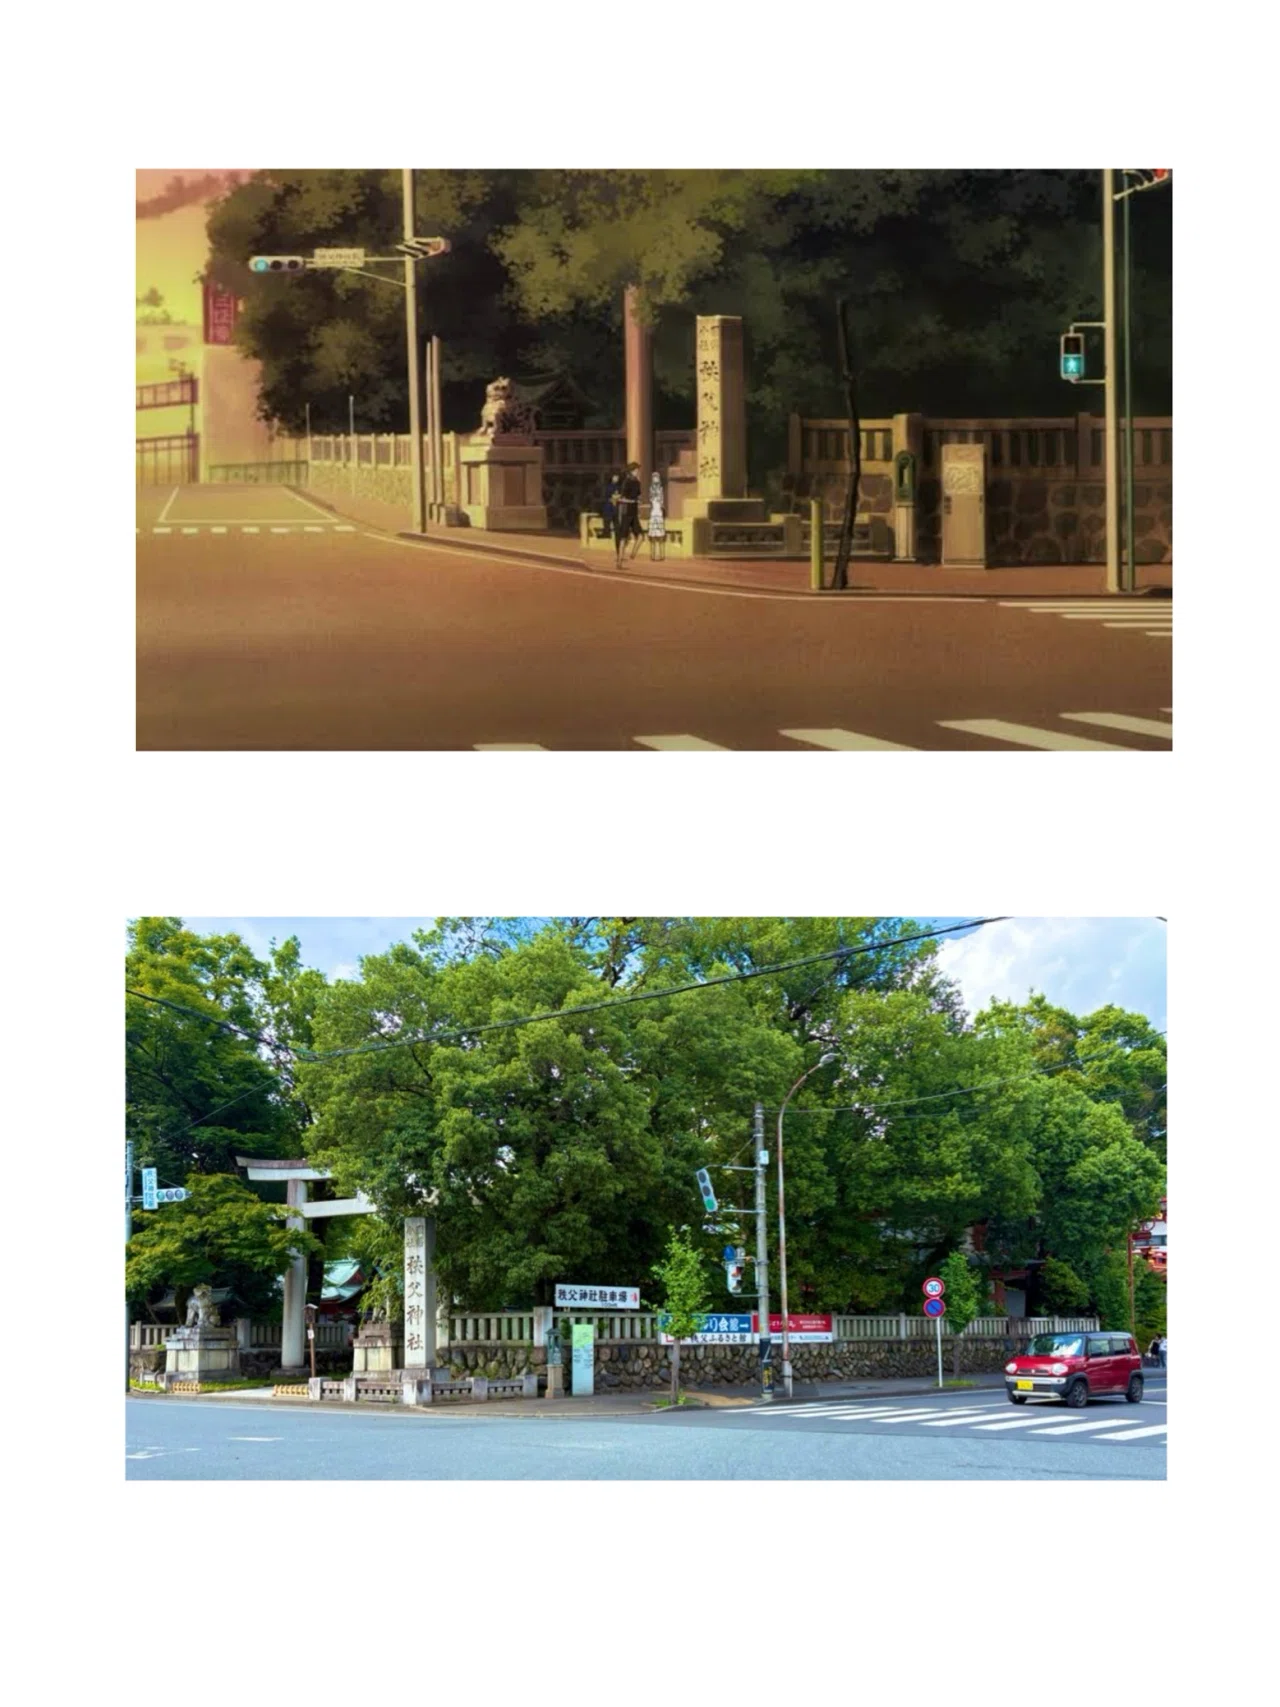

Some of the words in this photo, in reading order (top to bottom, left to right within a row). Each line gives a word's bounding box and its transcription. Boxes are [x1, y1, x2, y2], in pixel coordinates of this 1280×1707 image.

[928, 1283, 939, 1292] 30
[406, 1255, 424, 1351] 秩父神社
[558, 1289, 628, 1303] 秩父神社駐車場
